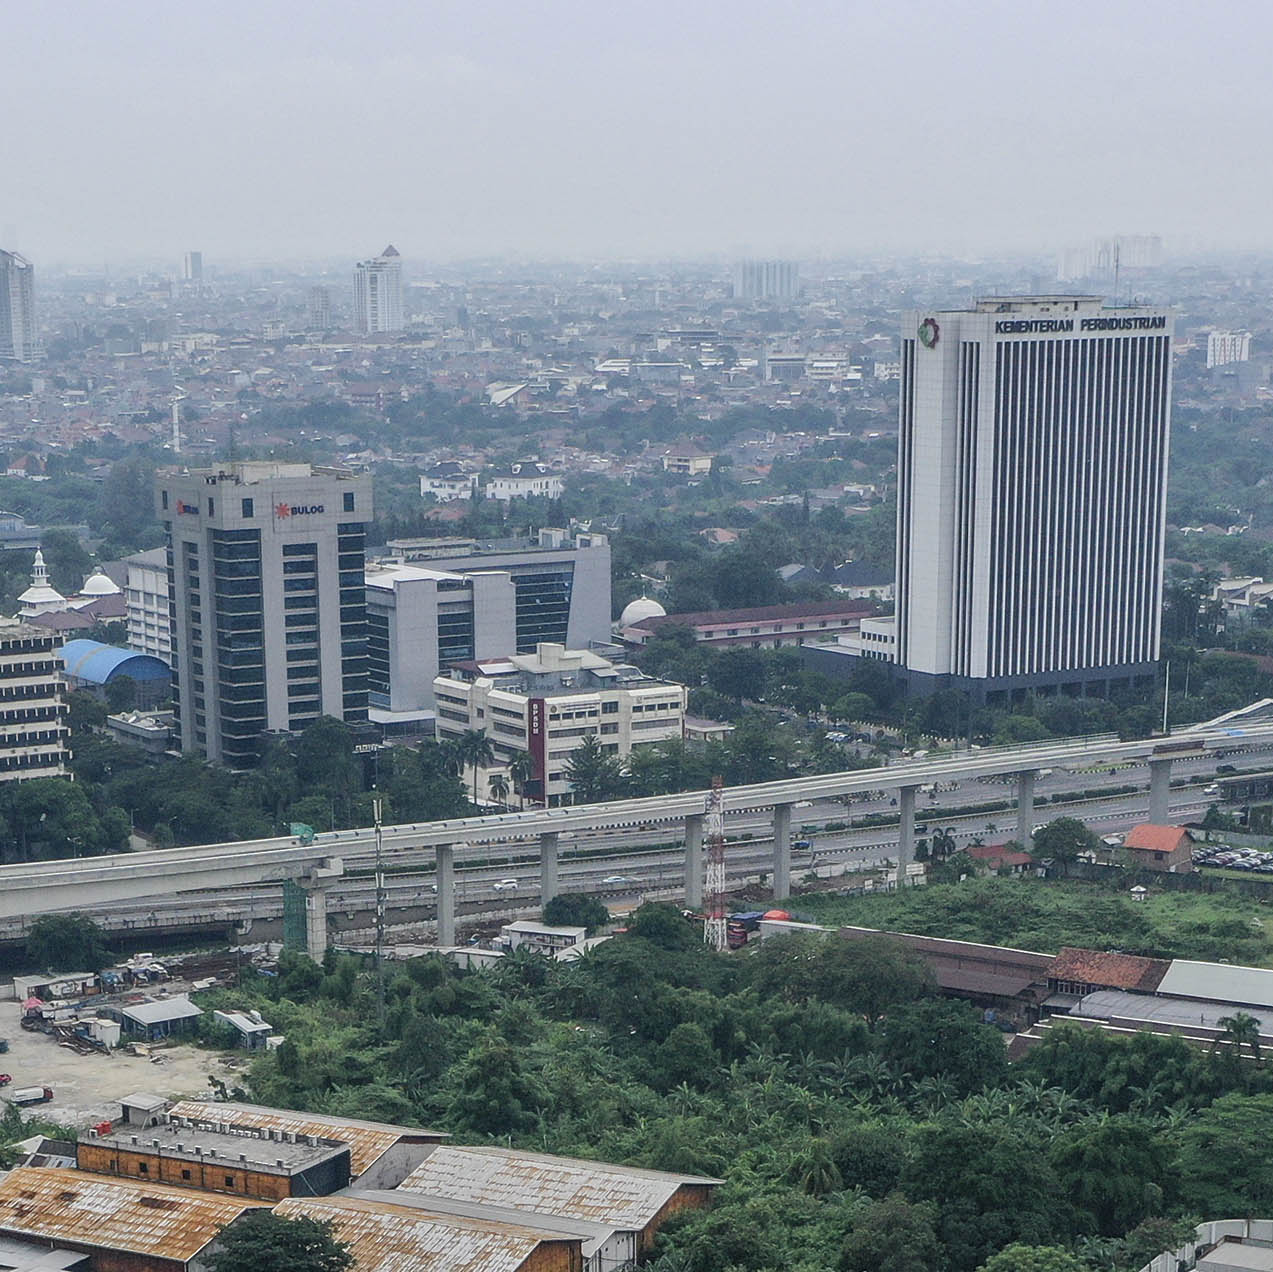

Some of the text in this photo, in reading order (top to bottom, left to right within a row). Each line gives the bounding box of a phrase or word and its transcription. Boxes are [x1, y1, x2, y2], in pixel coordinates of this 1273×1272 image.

[994, 316, 1166, 334] KEMENTERIAN PERINDUSTRIAN
[290, 505, 324, 516] BULOG
